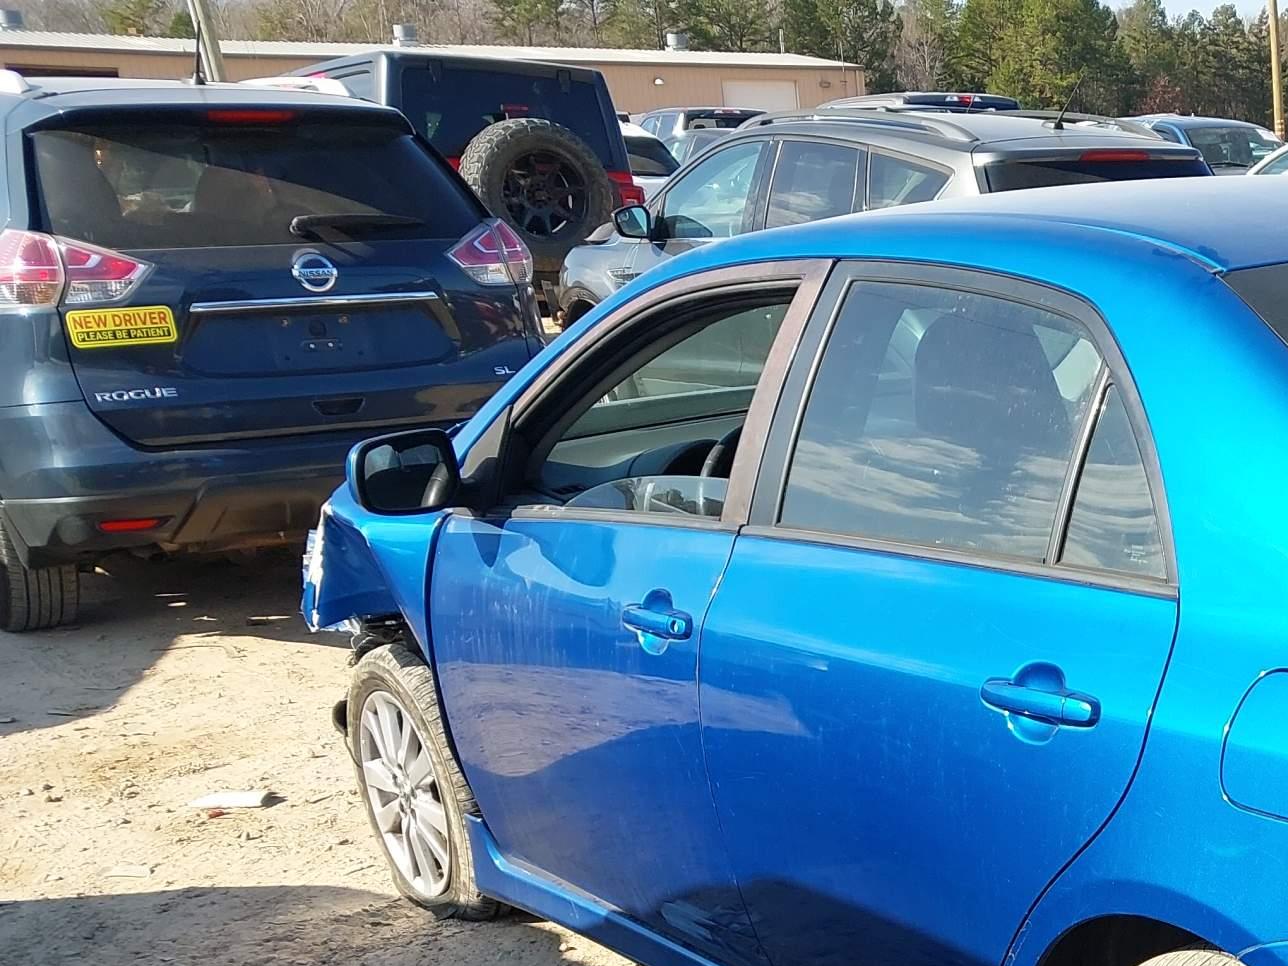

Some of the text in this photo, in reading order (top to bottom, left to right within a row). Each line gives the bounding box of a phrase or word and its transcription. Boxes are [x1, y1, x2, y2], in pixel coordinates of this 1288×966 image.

[298, 269, 333, 278] NISSAN
[72, 310, 169, 331] NEW DRIVER
[77, 326, 169, 342] PLEASE BE PATIENT
[493, 365, 517, 375] SL
[94, 387, 179, 402] ROGUE
